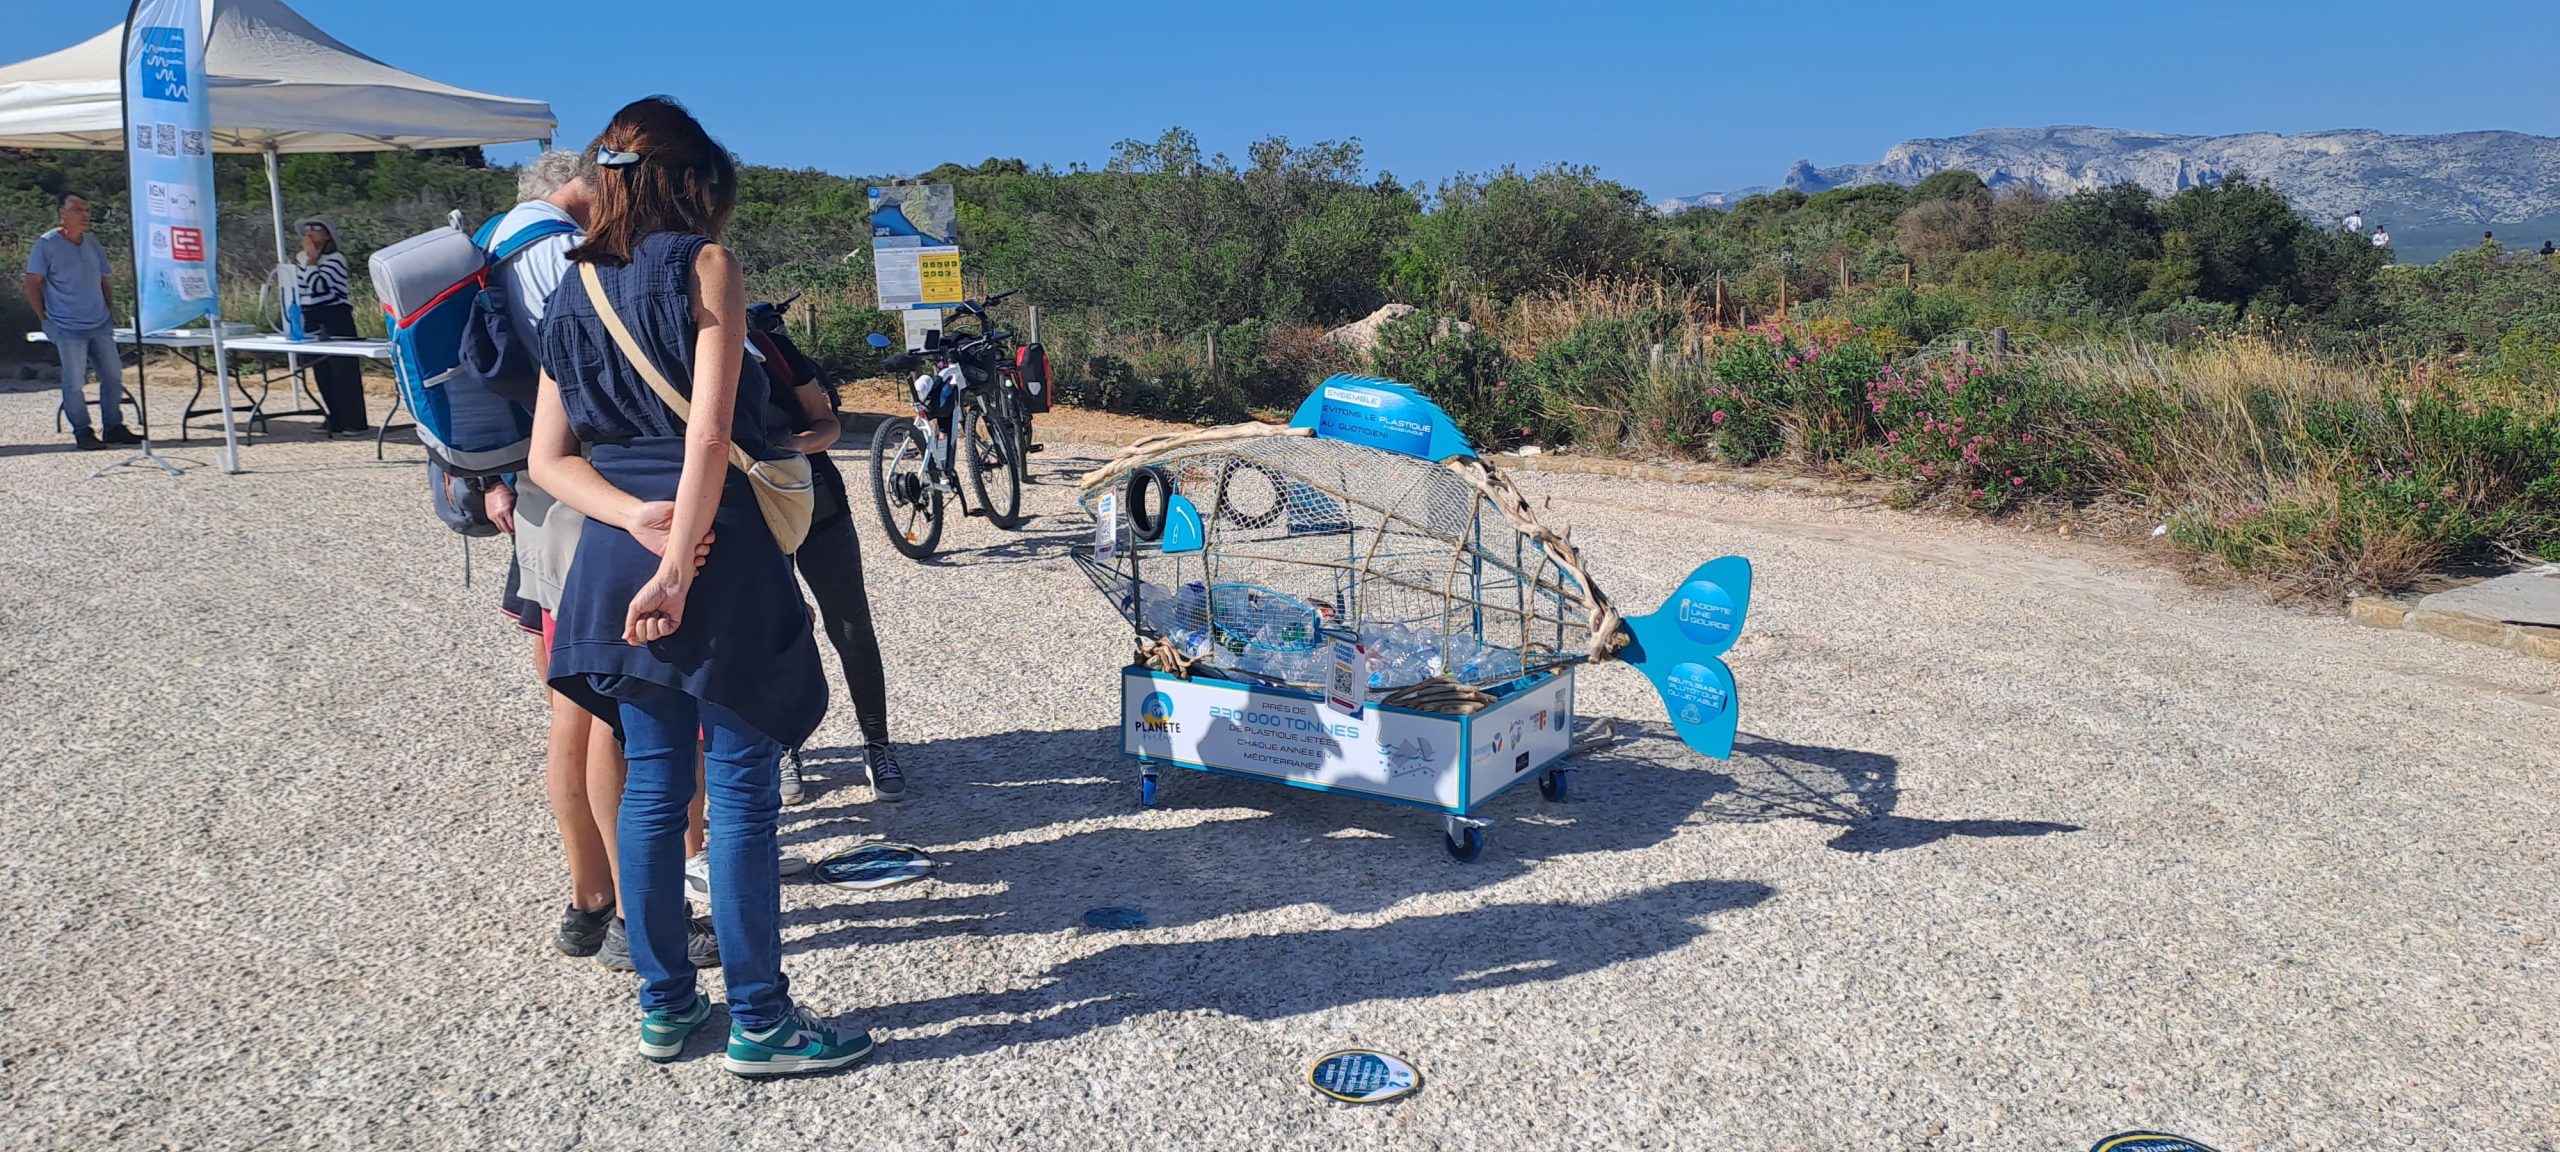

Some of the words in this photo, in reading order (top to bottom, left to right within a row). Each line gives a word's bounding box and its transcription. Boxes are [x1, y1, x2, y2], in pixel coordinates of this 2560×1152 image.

[1327, 388, 1379, 405] ENSEMBLE
[1320, 419, 1334, 428] AU
[1364, 412, 1376, 422] LE
[1378, 415, 1432, 432] PLASTIQUE
[1690, 608, 1712, 619] UNE
[1691, 602, 1731, 615] ADOPTE
[1690, 616, 1731, 631] GOURDE
[1681, 693, 1720, 709] JETABLE
[1292, 706, 1307, 716] DE
[1134, 719, 1181, 734] PLANÈTE
[1209, 706, 1244, 722] 230
[1247, 713, 1281, 727] 000
[1283, 716, 1360, 739] TONNES
[1228, 724, 1242, 733] DE
[1244, 726, 1298, 742] PLASTIQUE
[1237, 738, 1278, 752] CHAQUE
[1316, 751, 1332, 760] EN
